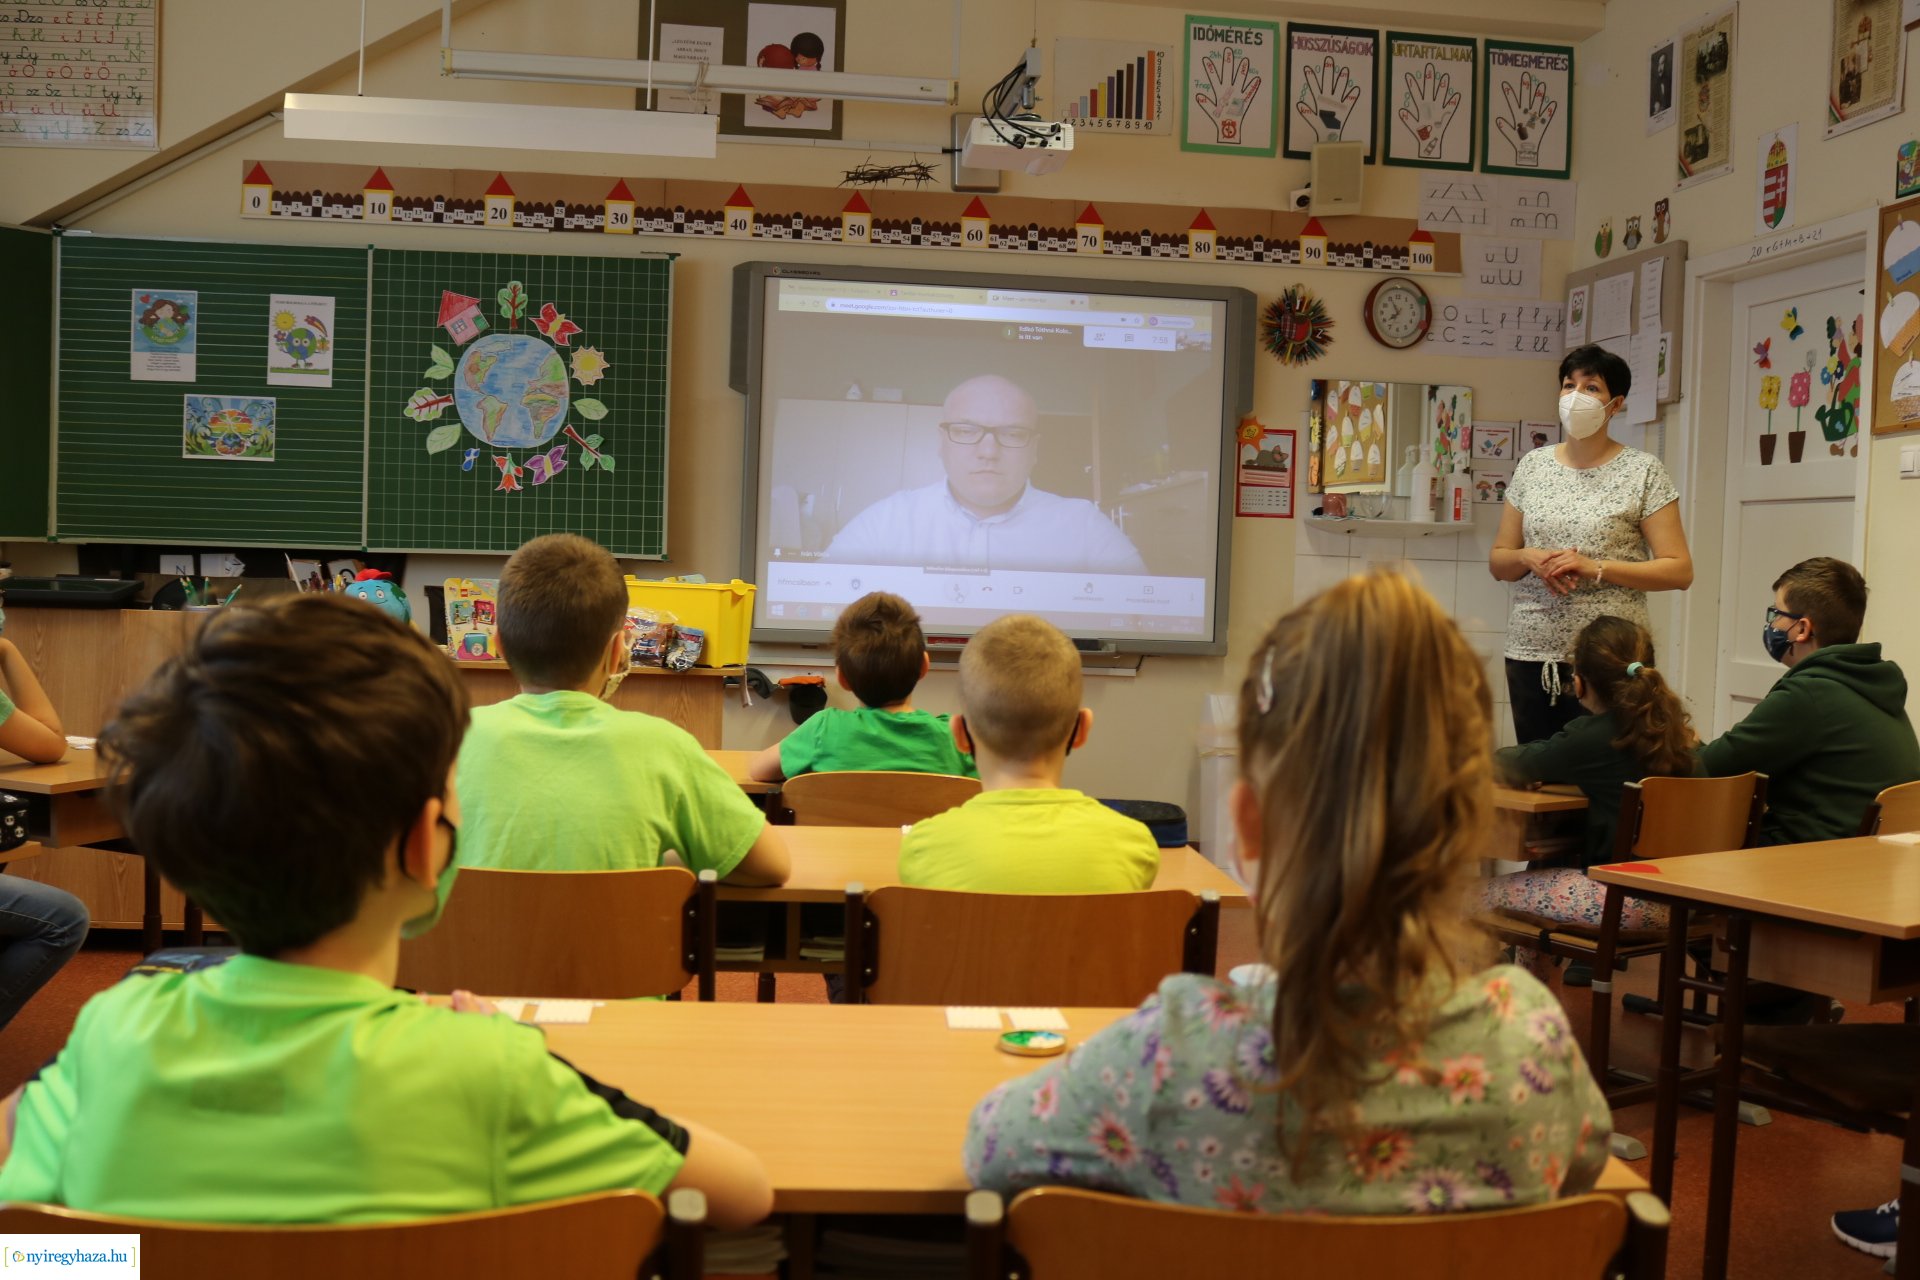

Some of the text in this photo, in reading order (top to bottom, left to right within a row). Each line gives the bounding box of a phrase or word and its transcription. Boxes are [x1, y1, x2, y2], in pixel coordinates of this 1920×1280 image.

[1292, 35, 1374, 57] HOSSZÚSÁGOK
[1079, 119, 1086, 127] 3
[1088, 119, 1094, 127] 4
[1097, 119, 1103, 128] 5
[1106, 119, 1113, 128] 6
[1115, 119, 1121, 127] 7
[1125, 120, 1131, 129] 8
[1135, 121, 1140, 129] 9
[1144, 121, 1153, 131] 10
[252, 196, 261, 209] 0
[284, 206, 289, 214] 2
[315, 197, 320, 205] 5
[370, 202, 386, 215] 10
[414, 208, 422, 216] 13
[424, 212, 432, 220] 14
[476, 211, 484, 219] 19
[490, 207, 508, 220] 20
[524, 217, 533, 225] 22
[575, 215, 584, 223] 27
[610, 212, 628, 225] 30
[644, 222, 653, 230] 32
[731, 218, 747, 231] 40
[823, 231, 832, 239] 48
[848, 224, 865, 237] 50
[892, 230, 900, 238] 53
[902, 235, 910, 243] 54
[932, 232, 940, 240] 57
[942, 236, 950, 244] 58
[967, 229, 983, 242] 60
[1081, 235, 1097, 248] 70
[1113, 245, 1122, 253] 72
[1195, 241, 1210, 254] 80
[1254, 242, 1263, 250] 85
[1305, 246, 1321, 259] 90
[1412, 252, 1433, 265] 100
[1750, 246, 1762, 259] 20
